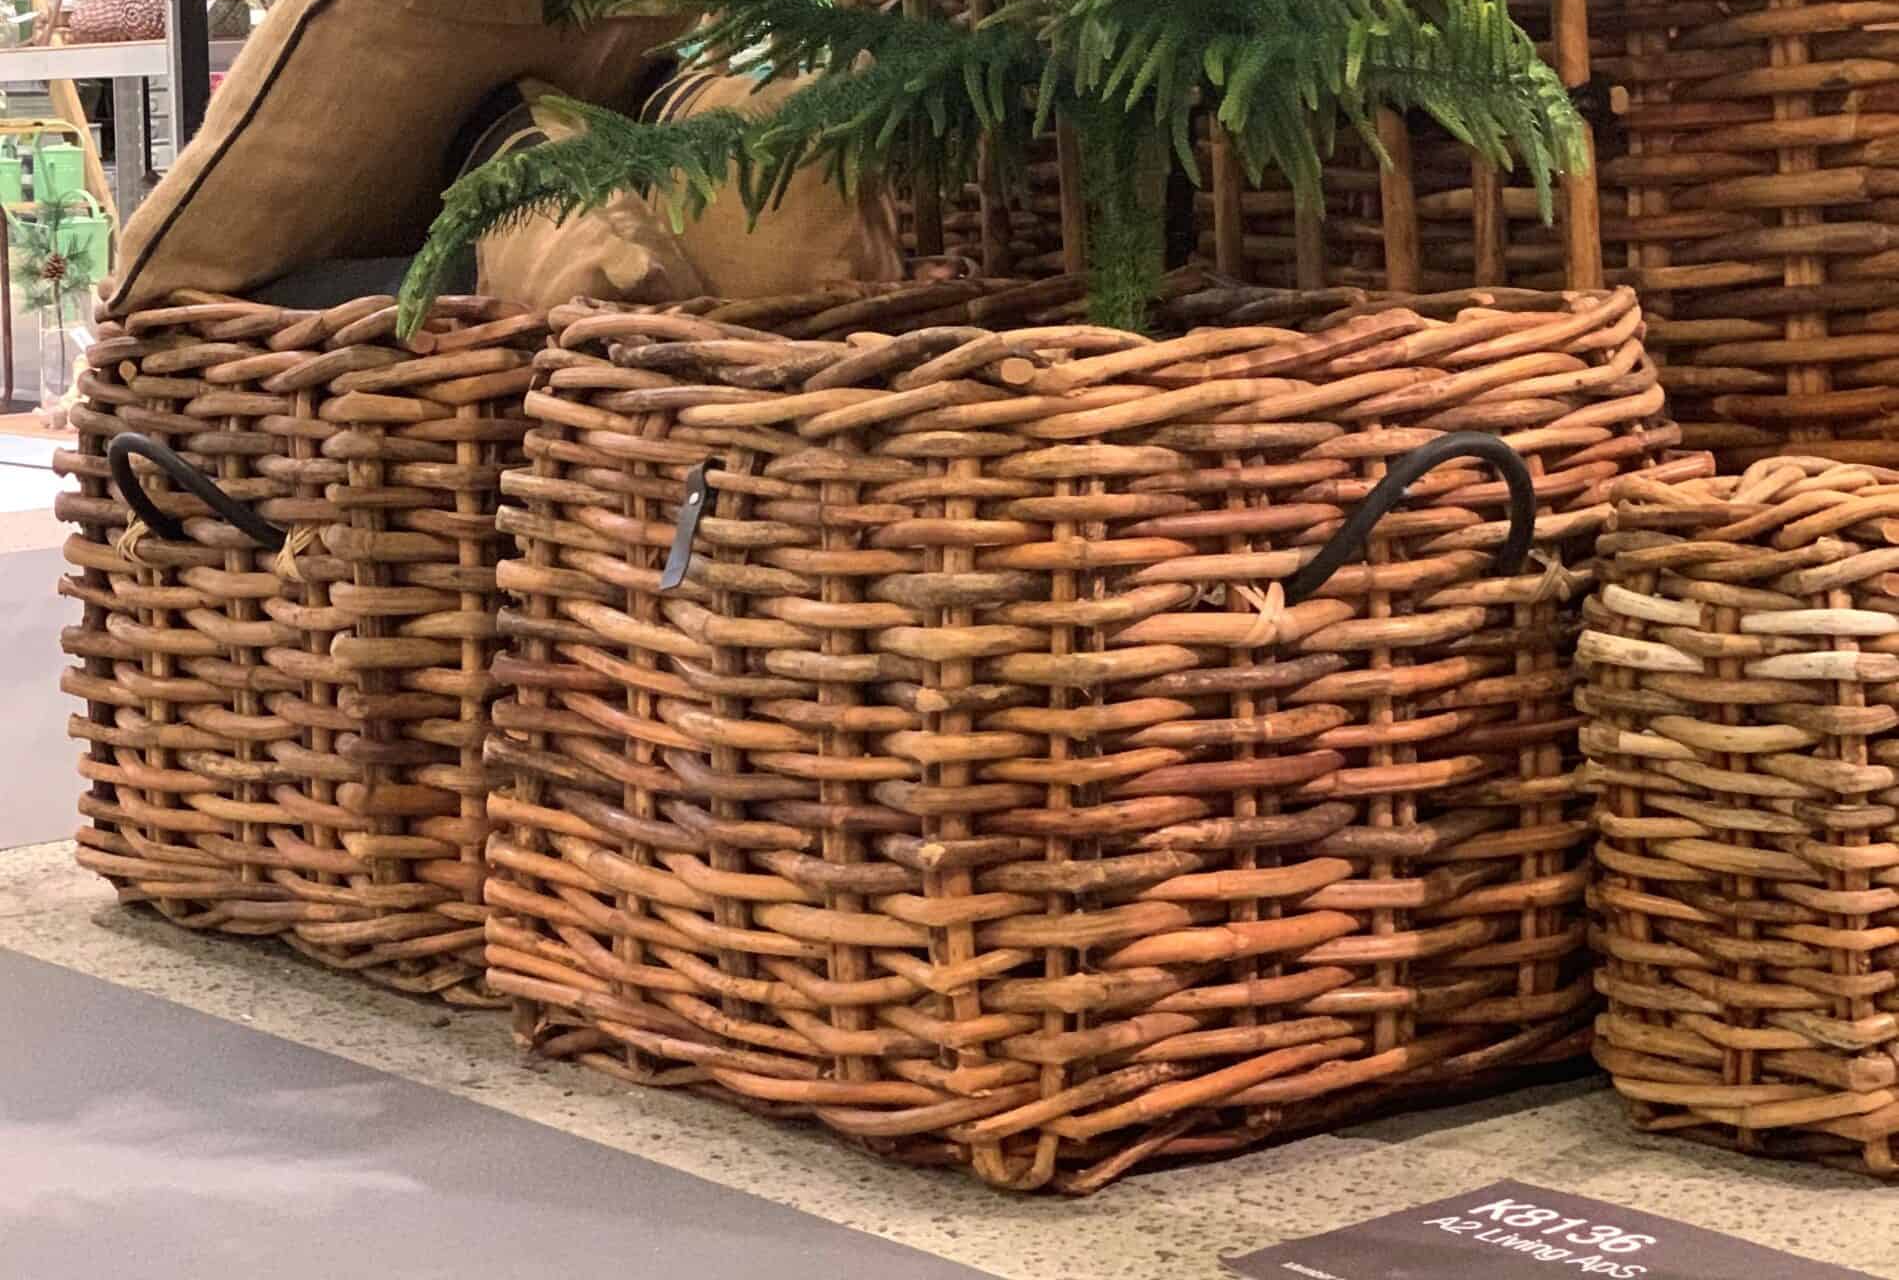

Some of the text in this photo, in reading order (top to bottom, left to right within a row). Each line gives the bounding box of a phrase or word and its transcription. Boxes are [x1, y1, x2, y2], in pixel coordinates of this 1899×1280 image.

[1422, 1215, 1649, 1279] A2 Living ApS
[1467, 1198, 1657, 1253] K8136
